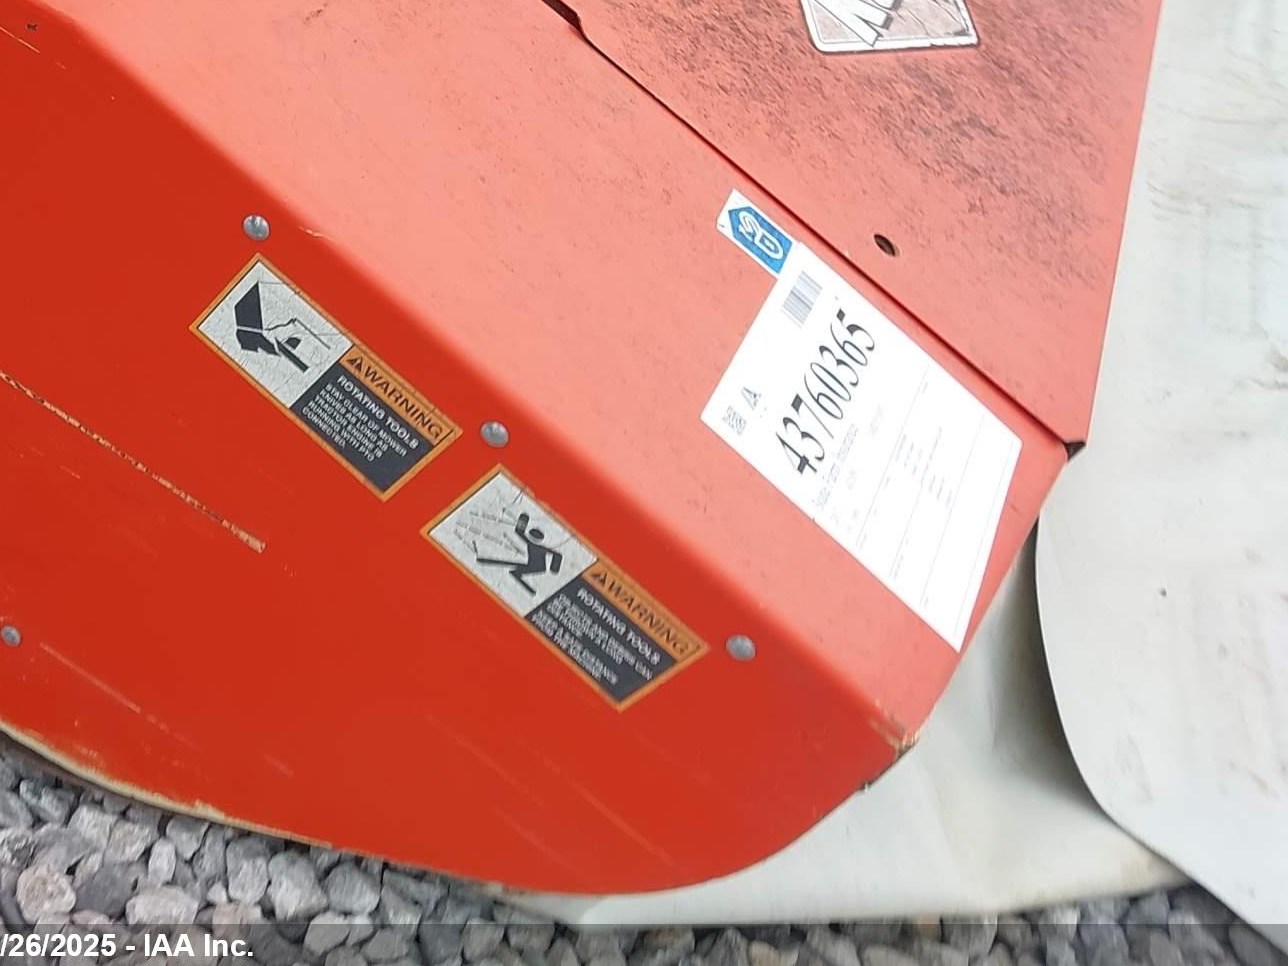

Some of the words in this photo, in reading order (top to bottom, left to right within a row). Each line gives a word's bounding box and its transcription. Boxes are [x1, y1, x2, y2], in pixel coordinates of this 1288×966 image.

[313, 394, 348, 426] TRACTOR
[345, 424, 374, 450] ENGINE
[319, 389, 346, 414] KNIVES
[355, 421, 378, 441] LONG
[325, 383, 344, 400] STAY
[342, 398, 369, 422] CLEAR
[377, 429, 407, 456] MOWER
[336, 375, 386, 419] ROTATING
[383, 416, 420, 449] TOOLS
[361, 365, 444, 438] WARNING
[773, 308, 875, 475] 43760365
[307, 400, 341, 431] RUNNING
[339, 429, 359, 448] WITH
[357, 445, 375, 461] PTO
[574, 587, 629, 635] ROTATING
[622, 630, 664, 665] TOOLS
[605, 580, 692, 654] WARNING
